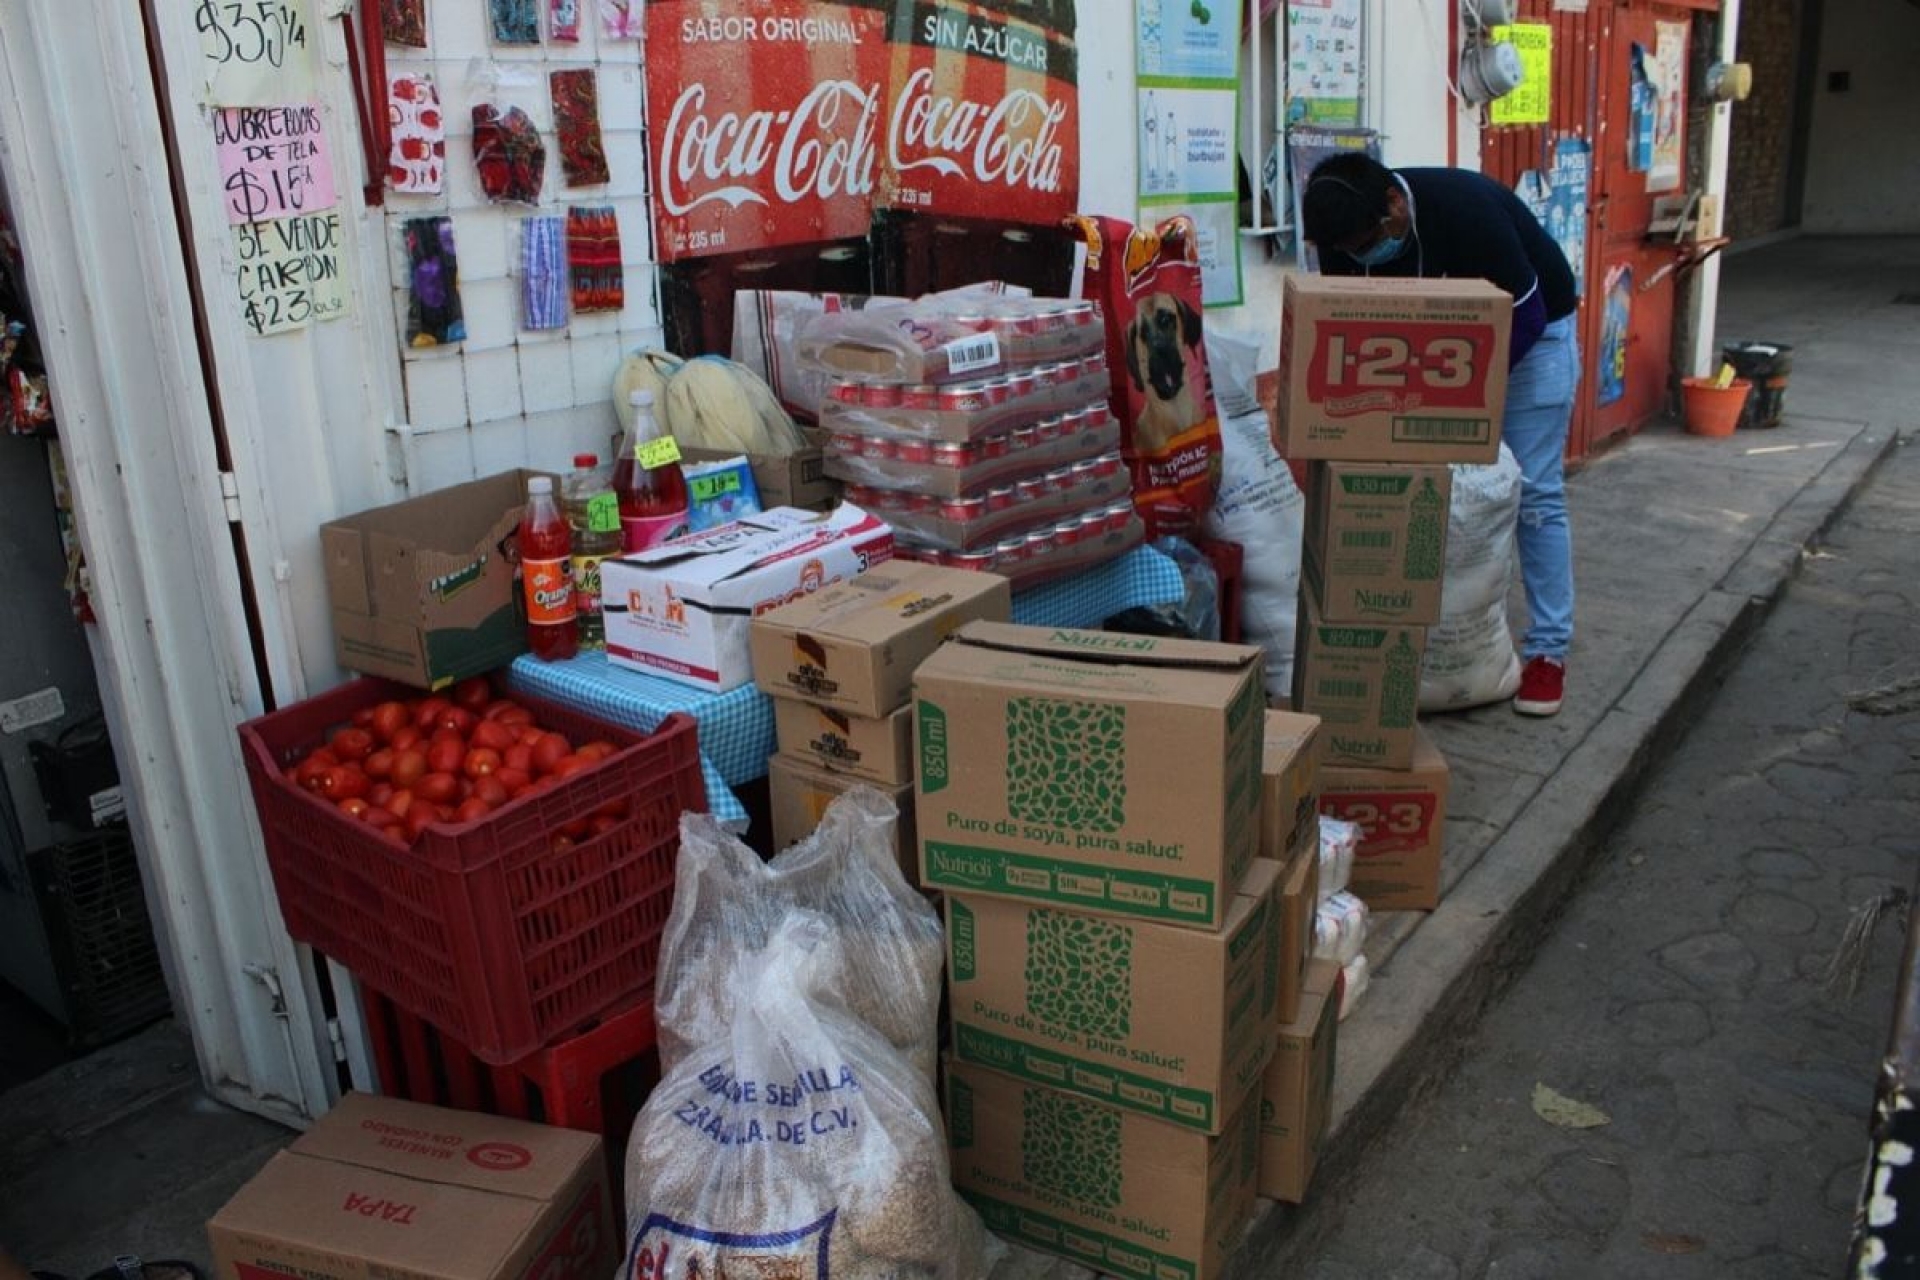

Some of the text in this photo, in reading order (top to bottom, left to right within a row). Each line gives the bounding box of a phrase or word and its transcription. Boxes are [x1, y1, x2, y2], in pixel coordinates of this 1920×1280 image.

[681, 16, 864, 46] SABOR ORIGINAL
[923, 15, 1049, 71] SIN AZÚCAR
[888, 67, 1069, 194] Coca-Cola
[242, 140, 319, 163] DE TELA
[239, 213, 339, 260] SE VENDE
[1352, 478, 1399, 494] 850 ml
[1354, 588, 1413, 611] Nutrioli
[1049, 630, 1159, 652] Nutrioli
[1357, 630, 1375, 646] ml
[923, 715, 946, 779] 850 ml
[1330, 735, 1388, 757] Nutrioli
[946, 811, 991, 834] Puro
[994, 817, 1019, 837] de
[1022, 822, 1071, 847] soya,
[1075, 831, 1120, 853] pura
[932, 849, 993, 878] Nutrioli
[955, 912, 974, 973] 850 ml
[973, 1000, 1011, 1023] Puro
[1013, 1010, 1035, 1030] de
[1038, 1020, 1083, 1044] soya,
[1086, 1036, 1128, 1057] pura
[776, 1119, 806, 1145] DE
[810, 1107, 857, 1135] C.V.
[343, 1190, 417, 1226] TAPA
[1079, 1203, 1117, 1226] pura
